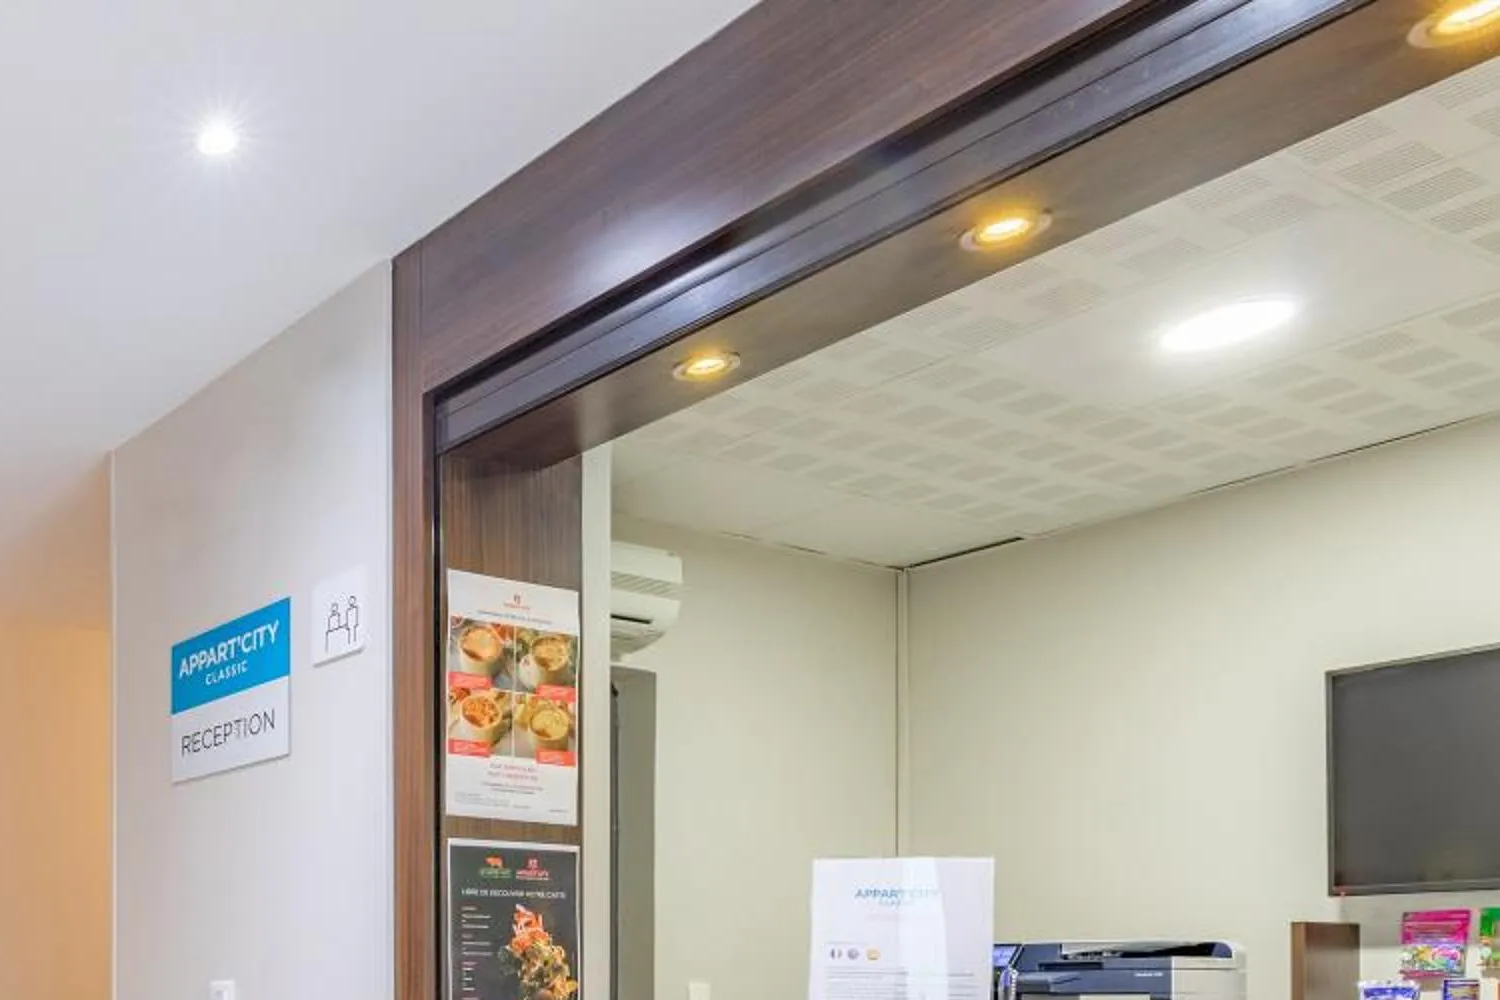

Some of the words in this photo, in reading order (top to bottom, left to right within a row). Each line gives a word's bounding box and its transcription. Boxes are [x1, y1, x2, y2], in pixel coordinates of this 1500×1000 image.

[179, 619, 280, 680] APPART'CITY
[205, 659, 249, 685] CLASSIC
[181, 707, 276, 757] RECEPTION
